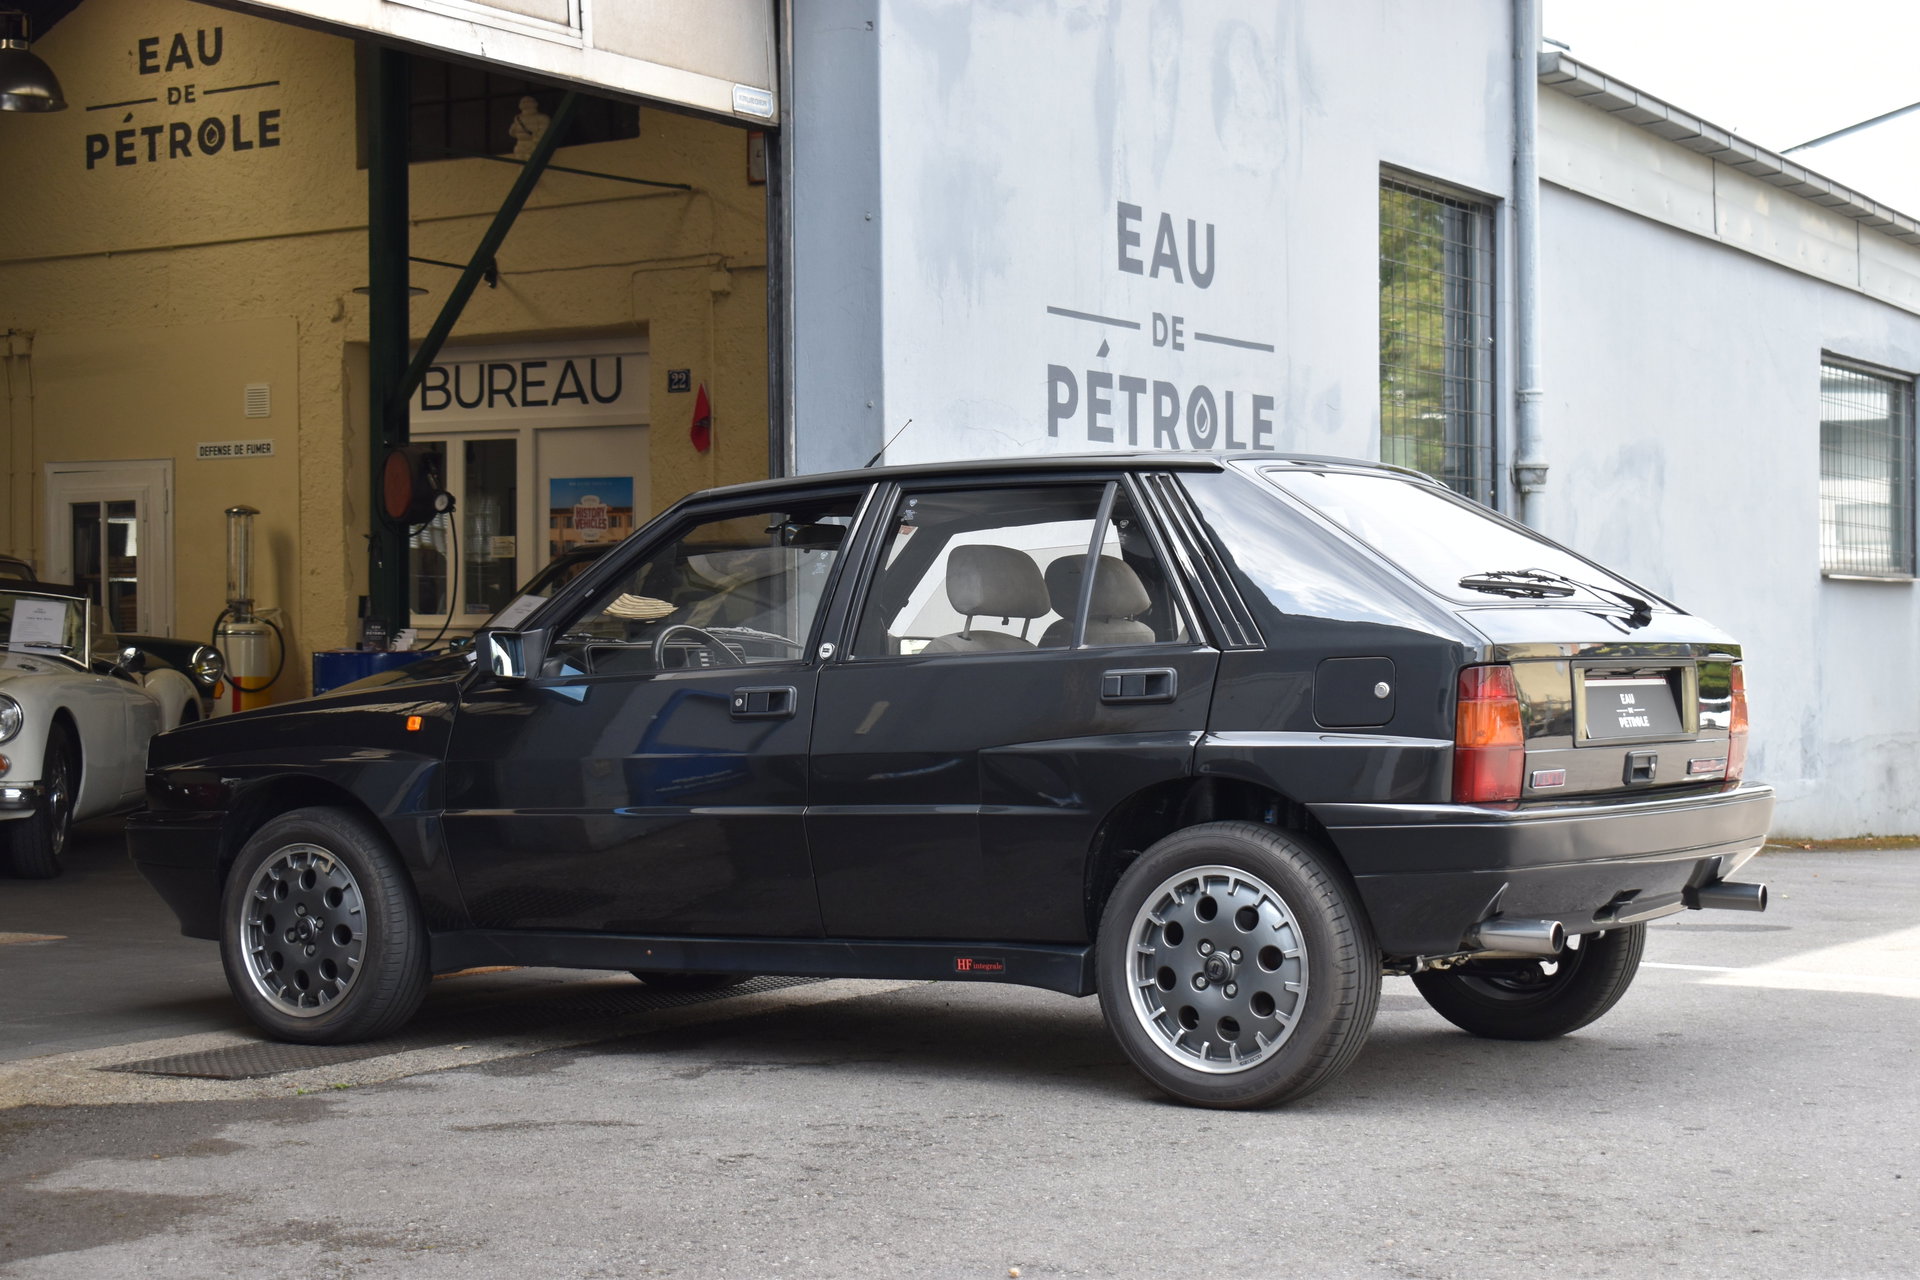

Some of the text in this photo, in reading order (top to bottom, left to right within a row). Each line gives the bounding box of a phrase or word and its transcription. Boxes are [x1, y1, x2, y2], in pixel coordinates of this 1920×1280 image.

[138, 27, 223, 75] EAU
[167, 84, 196, 105] DE
[86, 109, 280, 170] PÉTROLE
[1117, 200, 1215, 289] EAU
[1152, 312, 1185, 352] DE
[420, 357, 622, 411] BUREAU
[671, 372, 687, 389] 22
[1047, 338, 1275, 451] PÉTROLE
[200, 443, 271, 457] DEFENSE DE FUMER
[575, 506, 605, 518] HISTORY
[575, 518, 607, 530] VEHICLES
[1620, 693, 1635, 705] EAU
[1618, 713, 1650, 728] PÉTROLE
[957, 958, 1003, 971] HF integrale
